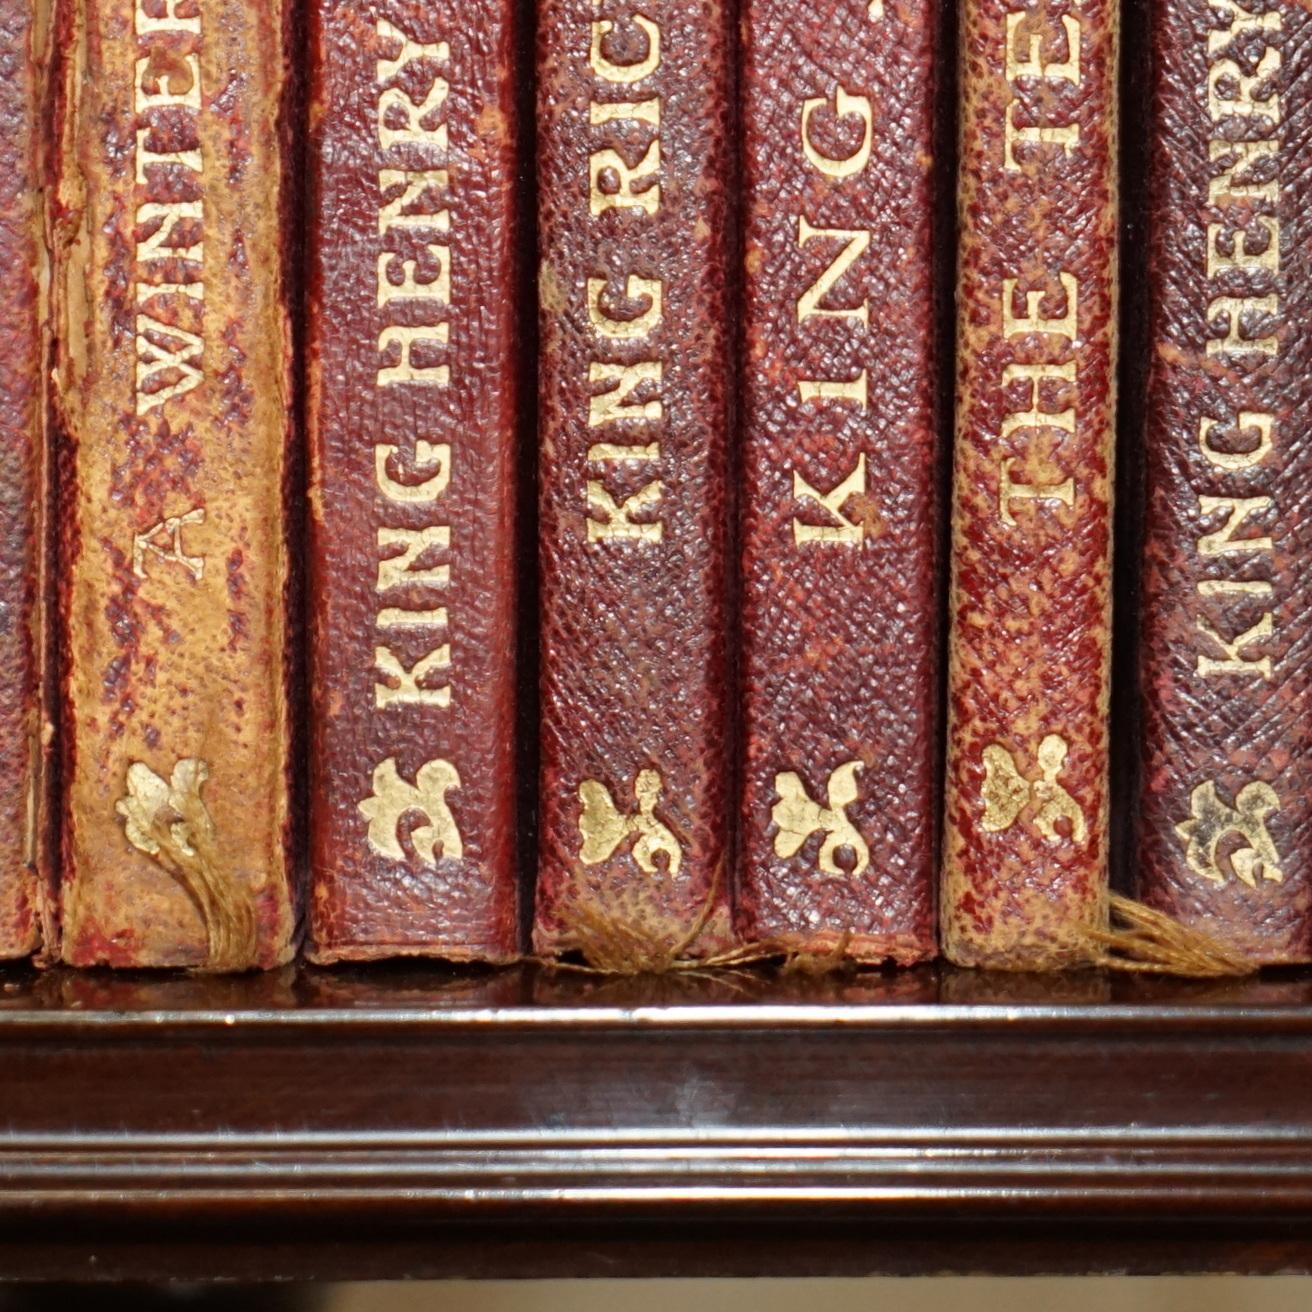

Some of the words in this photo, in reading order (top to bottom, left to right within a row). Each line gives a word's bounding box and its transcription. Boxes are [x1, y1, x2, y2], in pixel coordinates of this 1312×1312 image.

[377, 17, 450, 388] HENRY
[794, 86, 873, 548] KING
[587, 274, 663, 545] KING
[999, 272, 1080, 527] THE
[134, 508, 206, 578] A
[375, 439, 452, 710] KING
[1196, 410, 1275, 681] KING
